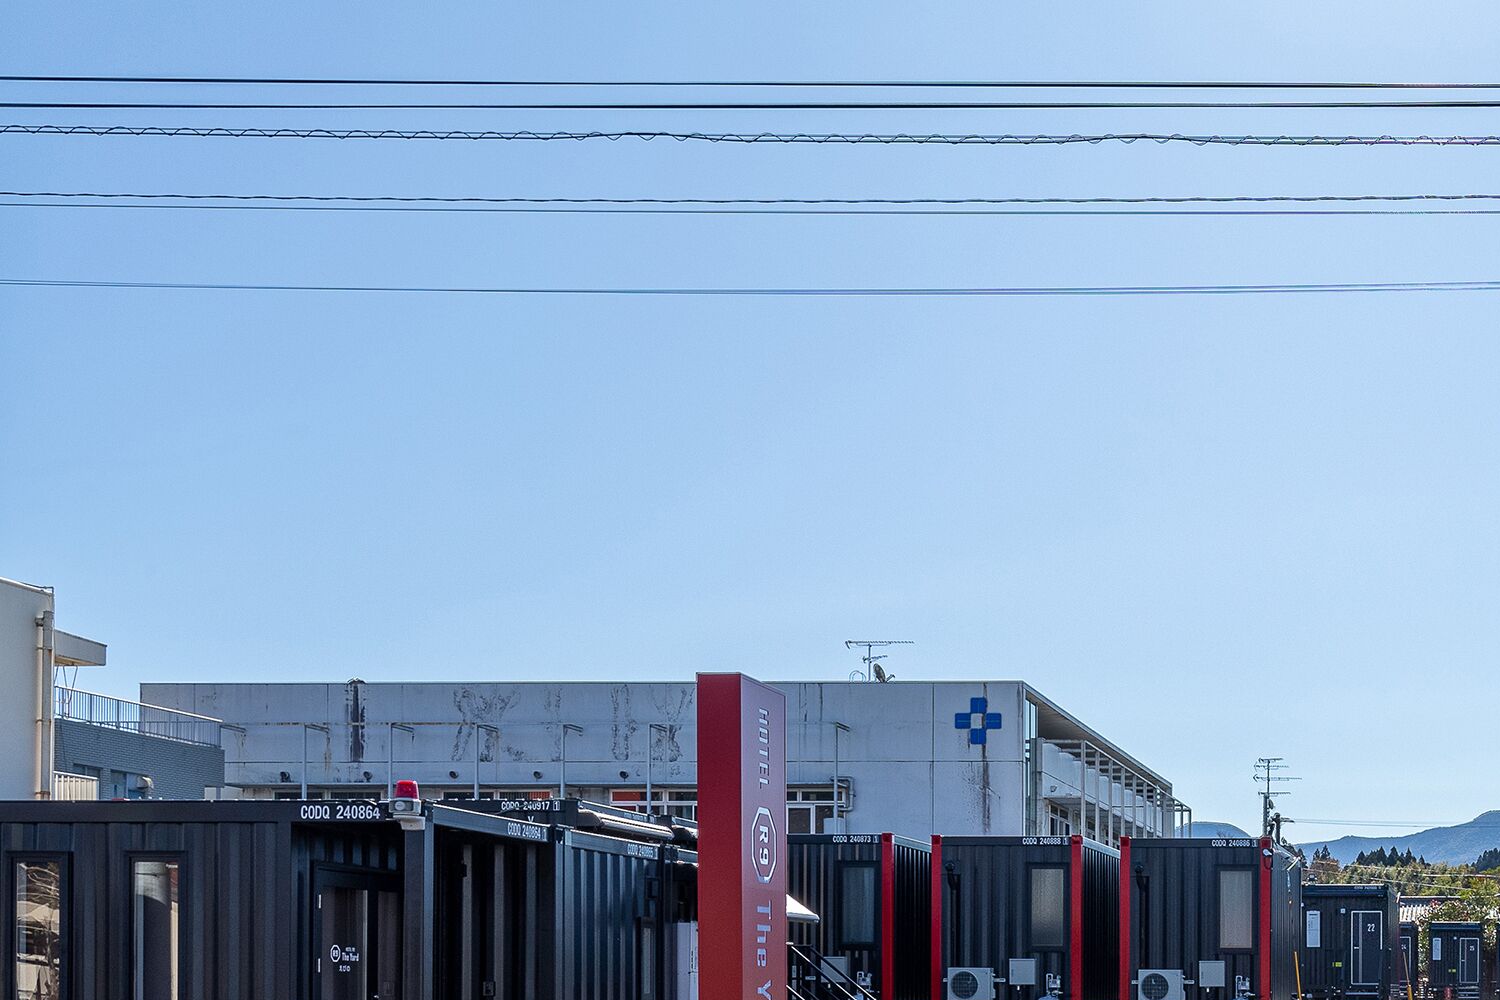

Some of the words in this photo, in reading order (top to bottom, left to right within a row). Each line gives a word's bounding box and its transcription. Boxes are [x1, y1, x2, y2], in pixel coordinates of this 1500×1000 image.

[758, 707, 770, 790] HOTEL
[300, 805, 330, 819] CODQ
[336, 805, 380, 819] 240864
[759, 825, 769, 865] R9
[756, 899, 772, 967] The
[1367, 923, 1376, 932] 22
